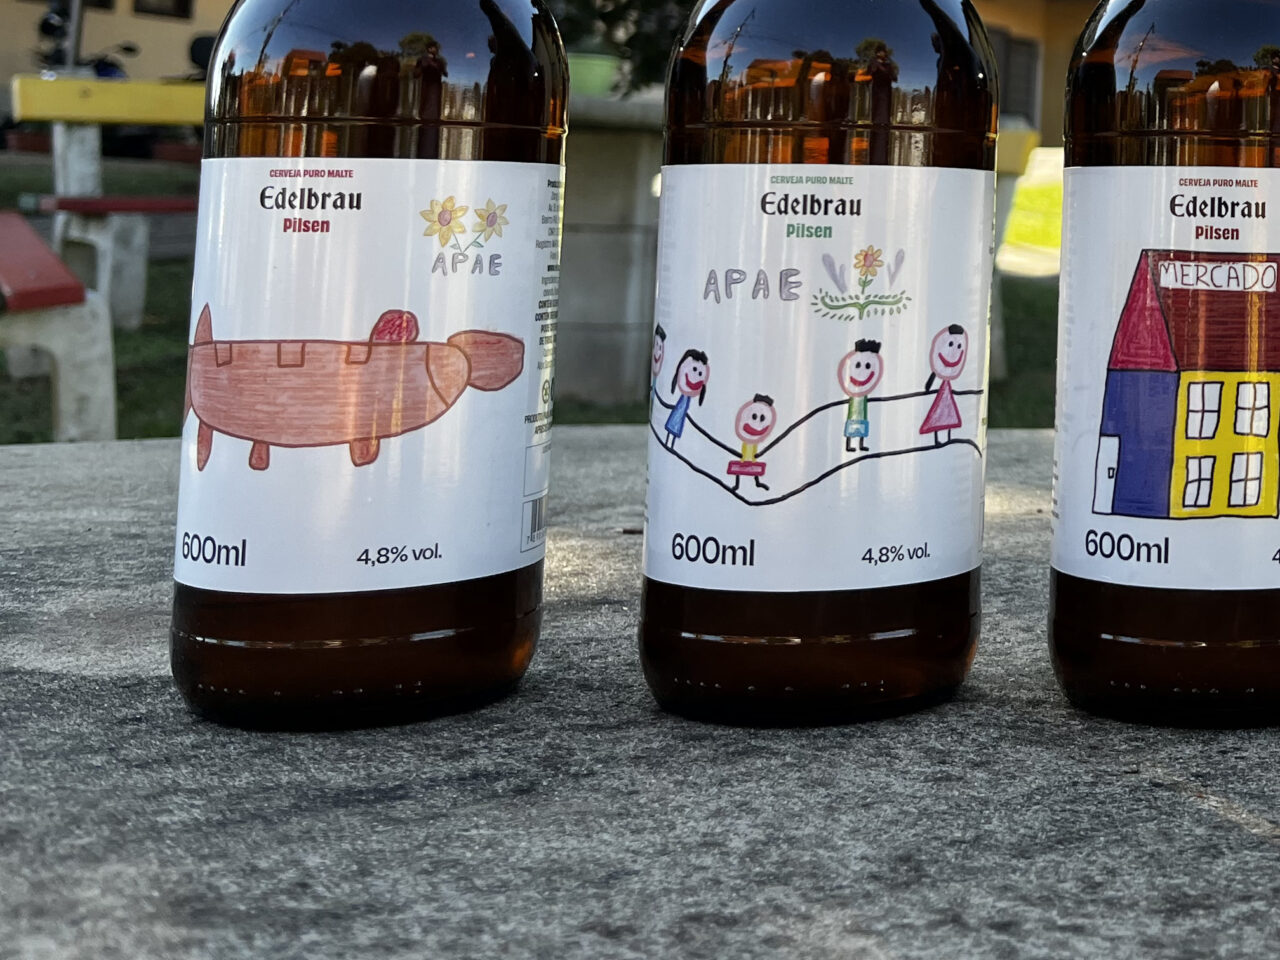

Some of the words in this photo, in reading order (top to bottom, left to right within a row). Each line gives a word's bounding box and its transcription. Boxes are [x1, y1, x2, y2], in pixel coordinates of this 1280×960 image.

[270, 169, 301, 178] CERVEJA
[303, 169, 326, 178] PURO
[328, 169, 354, 178] MALTE
[770, 175, 803, 185] CERVEJA
[805, 175, 827, 185] PURO
[829, 176, 854, 185] MALTE
[1178, 178, 1211, 187] CERVEJA
[1212, 178, 1234, 188] PURO
[1235, 179, 1259, 188] MALTE
[259, 185, 362, 211] Edelbrau
[760, 191, 862, 217] Edelbrau
[1169, 193, 1267, 219] Edelbrau
[283, 217, 331, 233] Pilsen
[786, 223, 833, 239] Pilsen
[1195, 225, 1240, 241] Pilsen
[431, 251, 503, 277] APAE
[1159, 262, 1277, 290] MERCADO
[703, 268, 803, 304] APAE
[182, 531, 247, 567] 600ml
[356, 545, 408, 567] 4,8%
[412, 542, 443, 561] vol.
[671, 532, 755, 566] 600ml
[861, 544, 905, 566] 4,8%
[907, 542, 931, 559] vol.
[1085, 529, 1170, 564] 600ml
